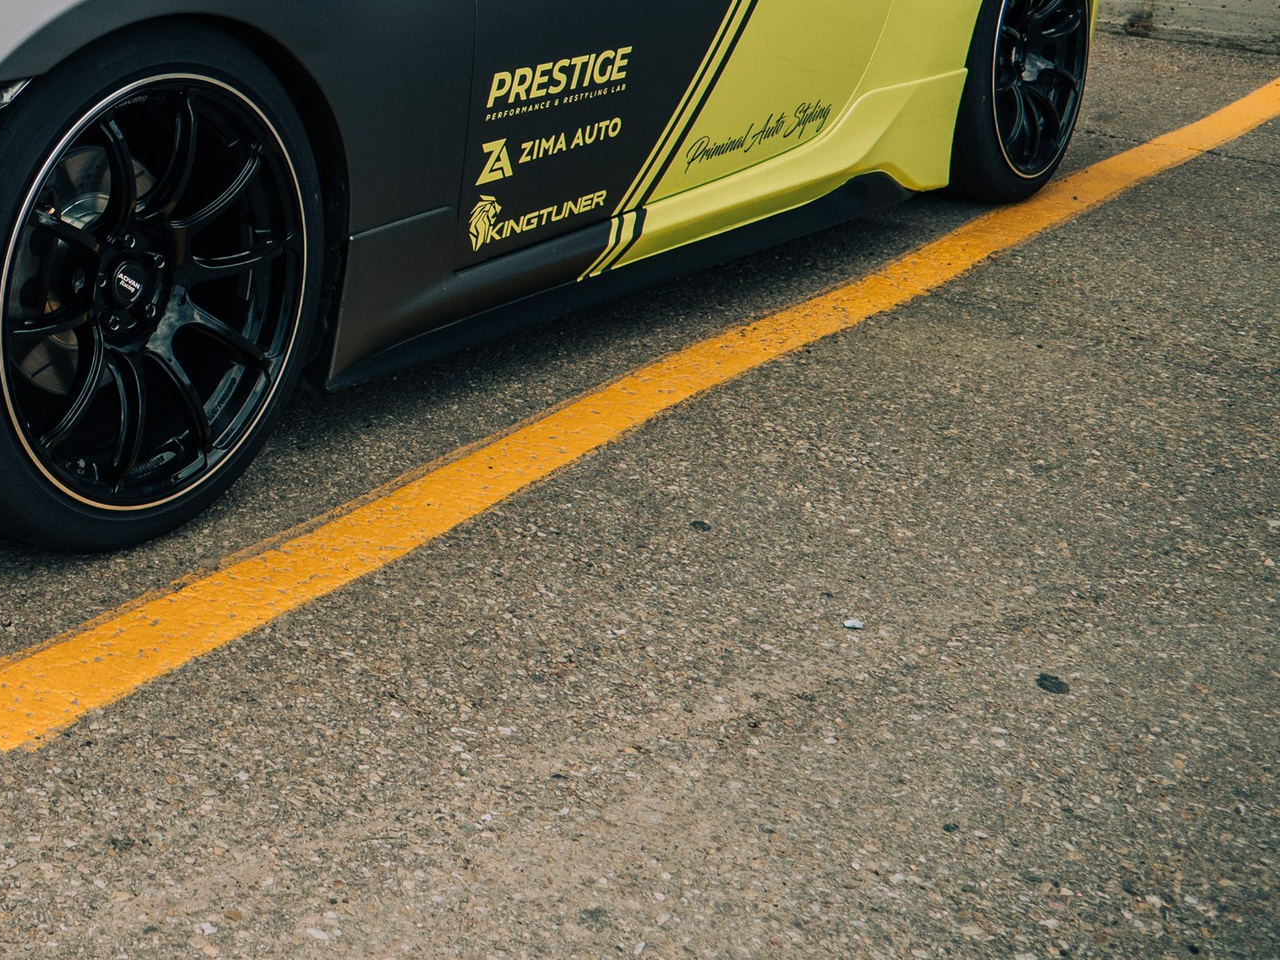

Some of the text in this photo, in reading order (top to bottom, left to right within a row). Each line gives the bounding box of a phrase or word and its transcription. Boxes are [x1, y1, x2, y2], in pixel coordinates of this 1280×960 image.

[486, 46, 633, 108] PRESTIGE
[485, 100, 551, 122] PERFORMANCE
[563, 88, 609, 104] RESTYLING
[611, 83, 627, 93] LAB
[744, 112, 789, 153] Auto
[783, 99, 833, 140] Styling
[518, 117, 622, 164] ZIMA AUTO
[486, 190, 607, 243] KINGTUNER
[118, 272, 140, 289] ADVAN
[120, 280, 135, 293] Racing
